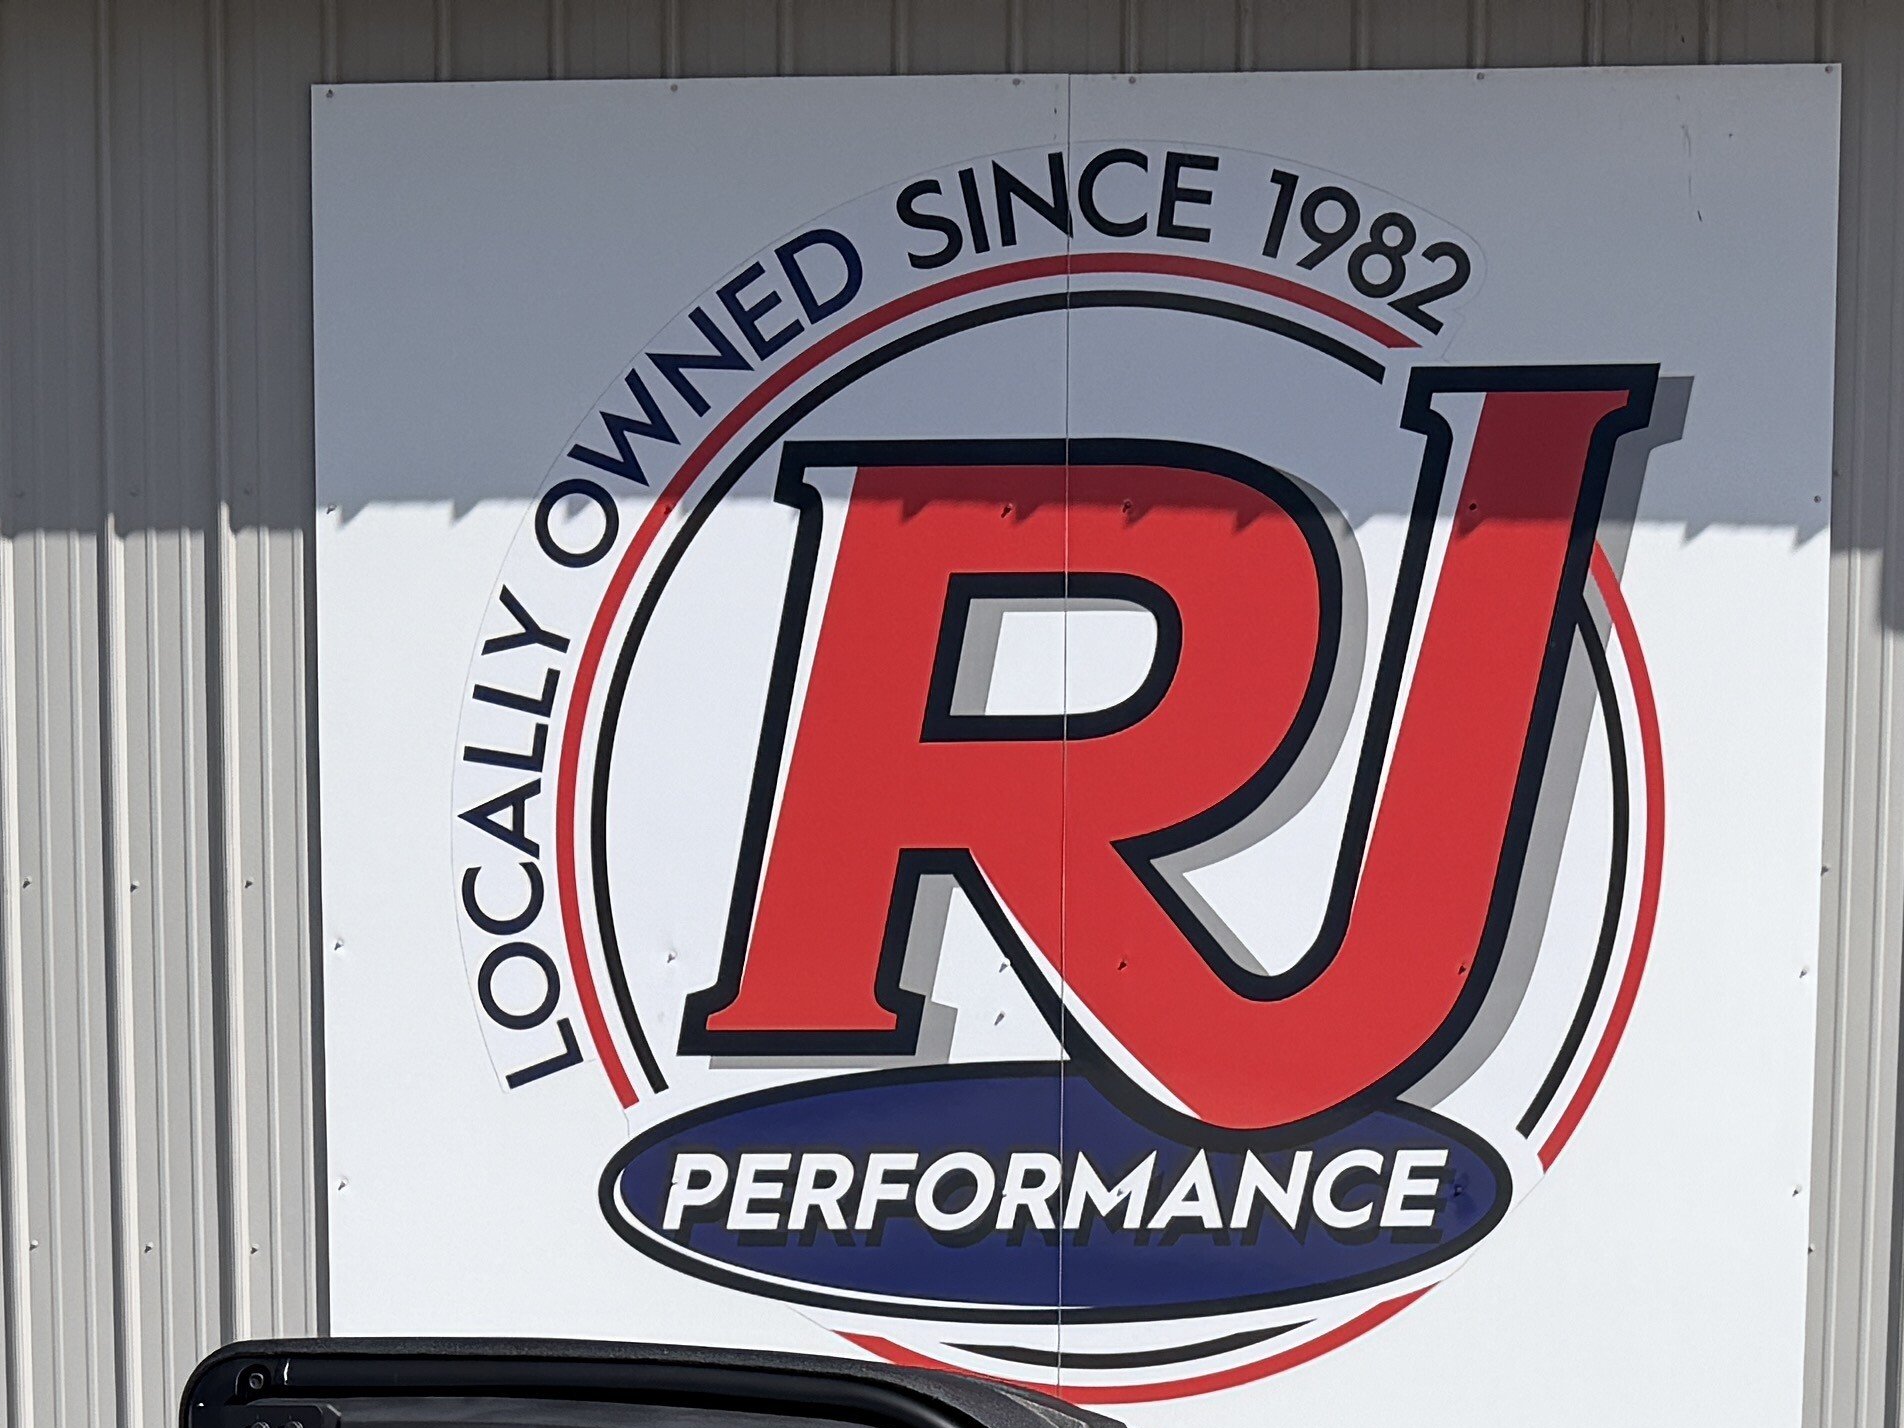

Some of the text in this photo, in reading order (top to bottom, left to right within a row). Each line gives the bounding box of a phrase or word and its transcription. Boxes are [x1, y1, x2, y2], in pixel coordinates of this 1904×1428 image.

[459, 149, 1473, 1090] LOCALLY OWNED SINCE 1982
[679, 362, 1660, 1152] RJ
[662, 1150, 1447, 1231] PERFORMANCE
